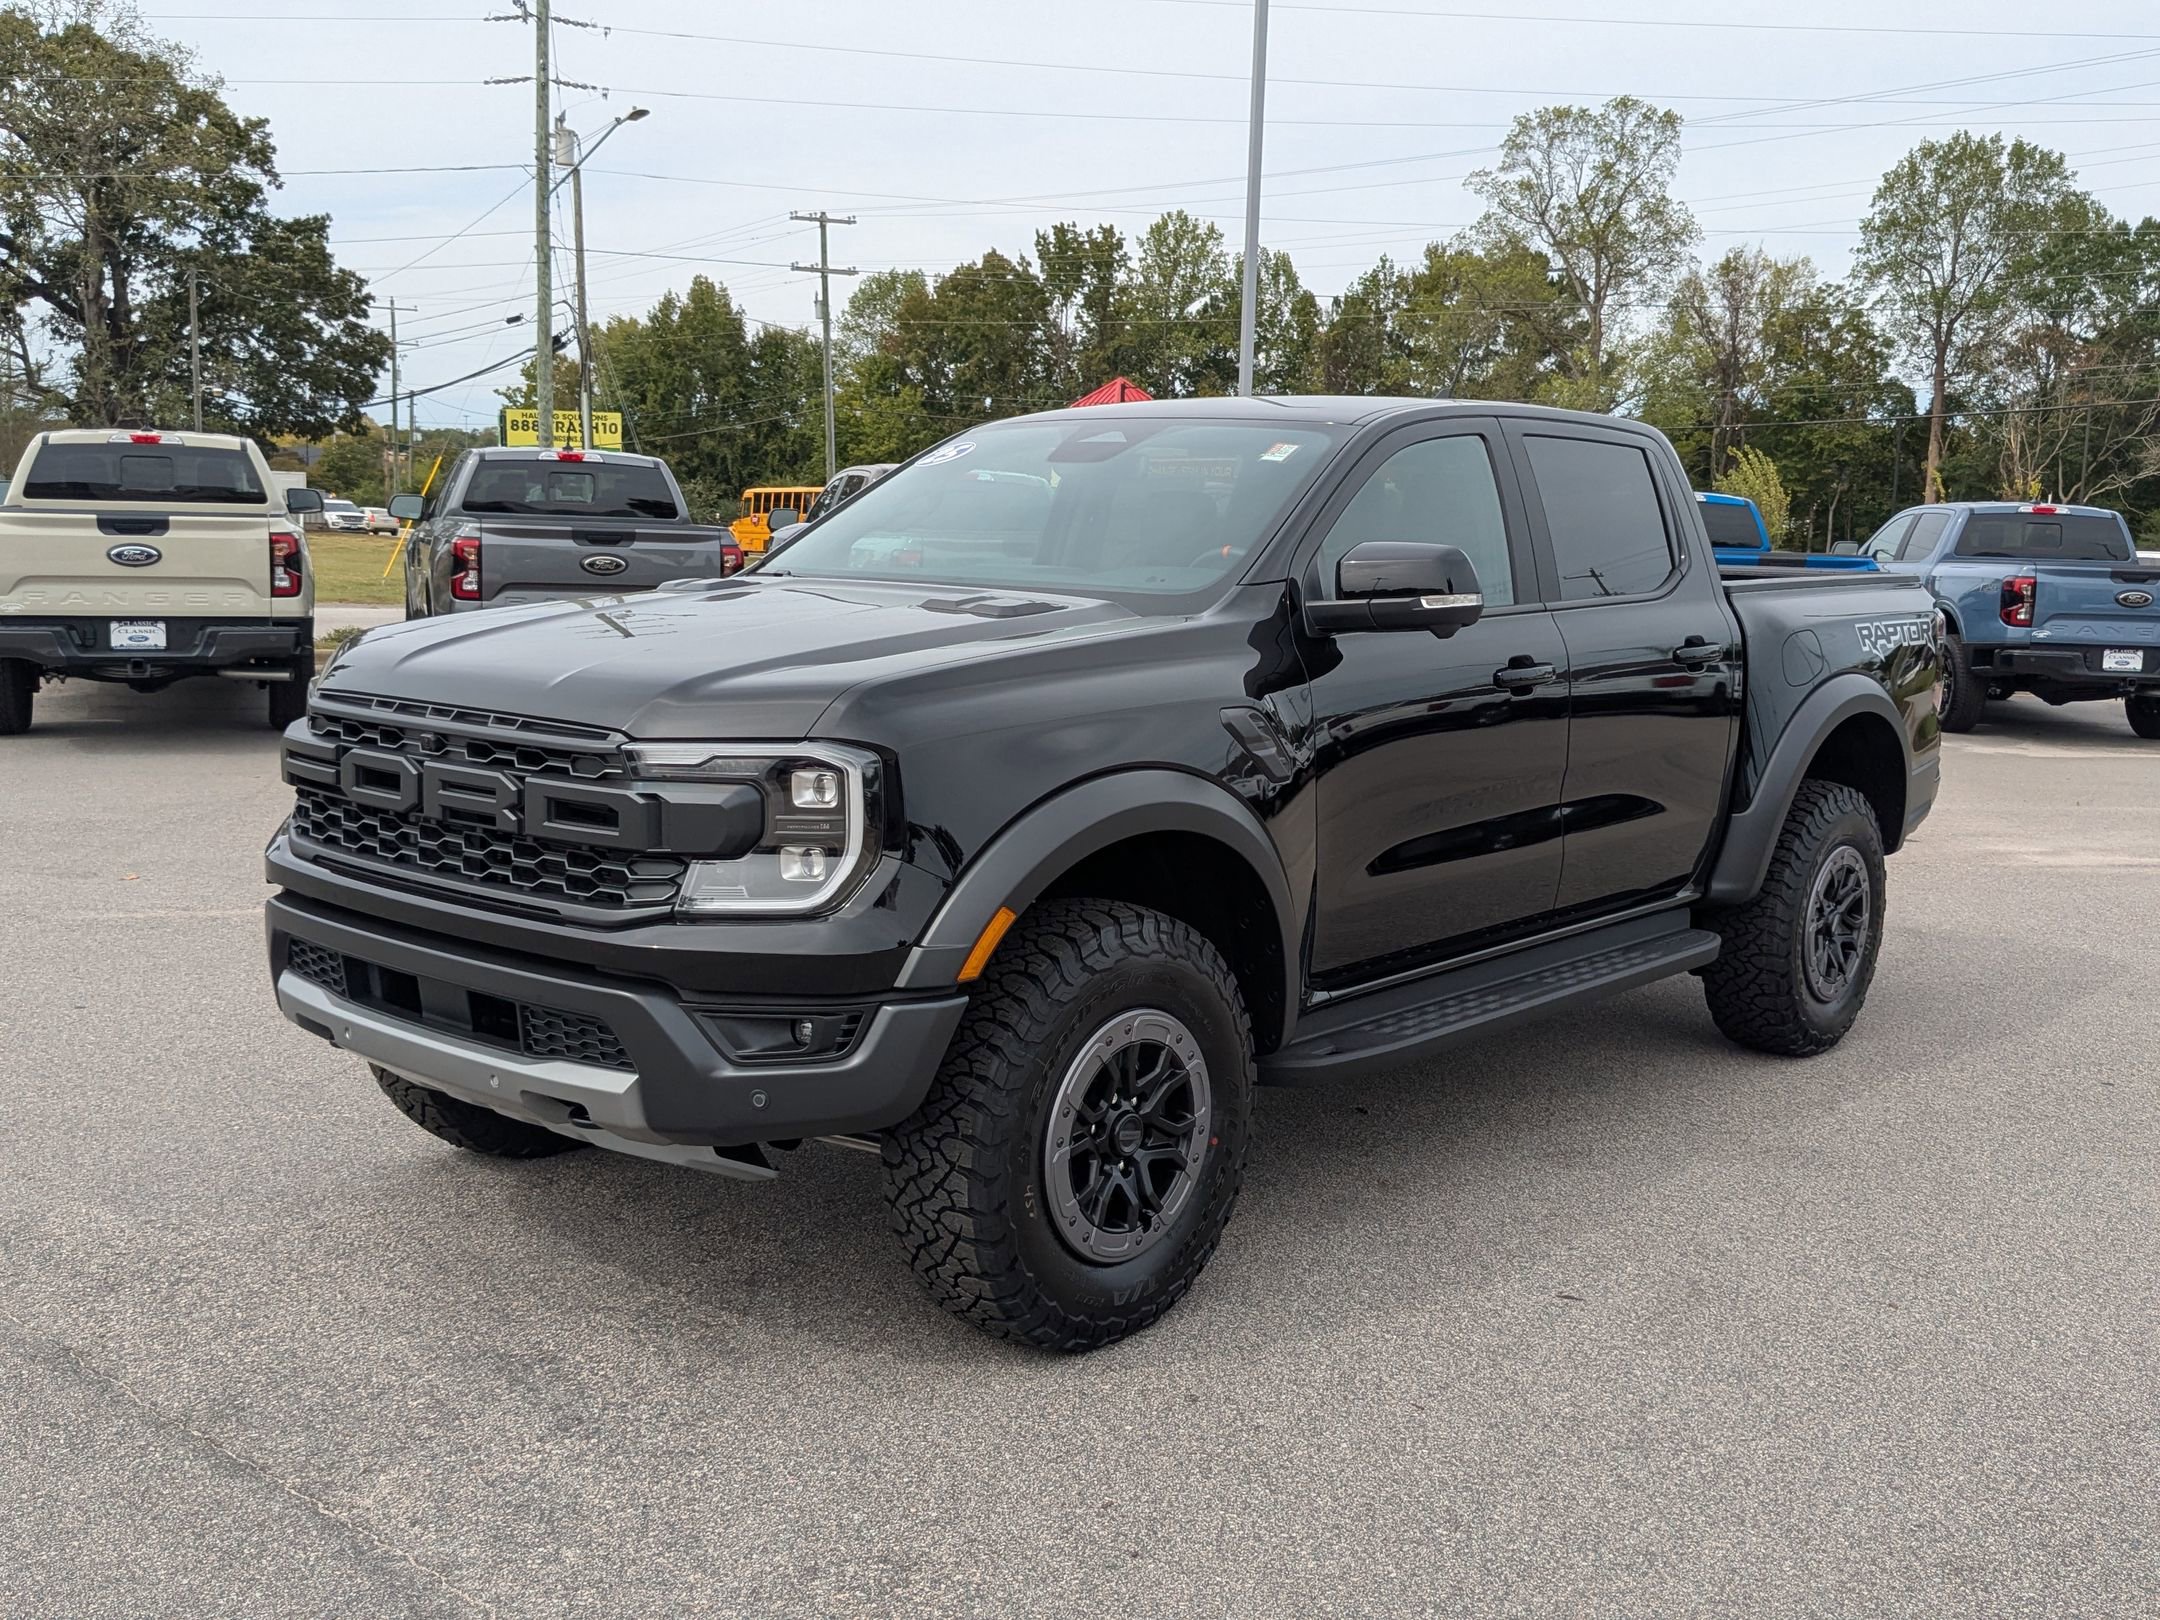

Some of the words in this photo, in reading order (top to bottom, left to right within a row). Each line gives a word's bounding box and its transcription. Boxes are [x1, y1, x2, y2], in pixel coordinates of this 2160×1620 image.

[521, 412, 560, 420] HAUG
[562, 413, 608, 422] SOLONS
[121, 549, 147, 561] Ford
[593, 559, 617, 570] Ford
[22, 590, 255, 607] RANGER
[1855, 618, 1936, 662] RAPTOR
[281, 733, 652, 852] FORD
